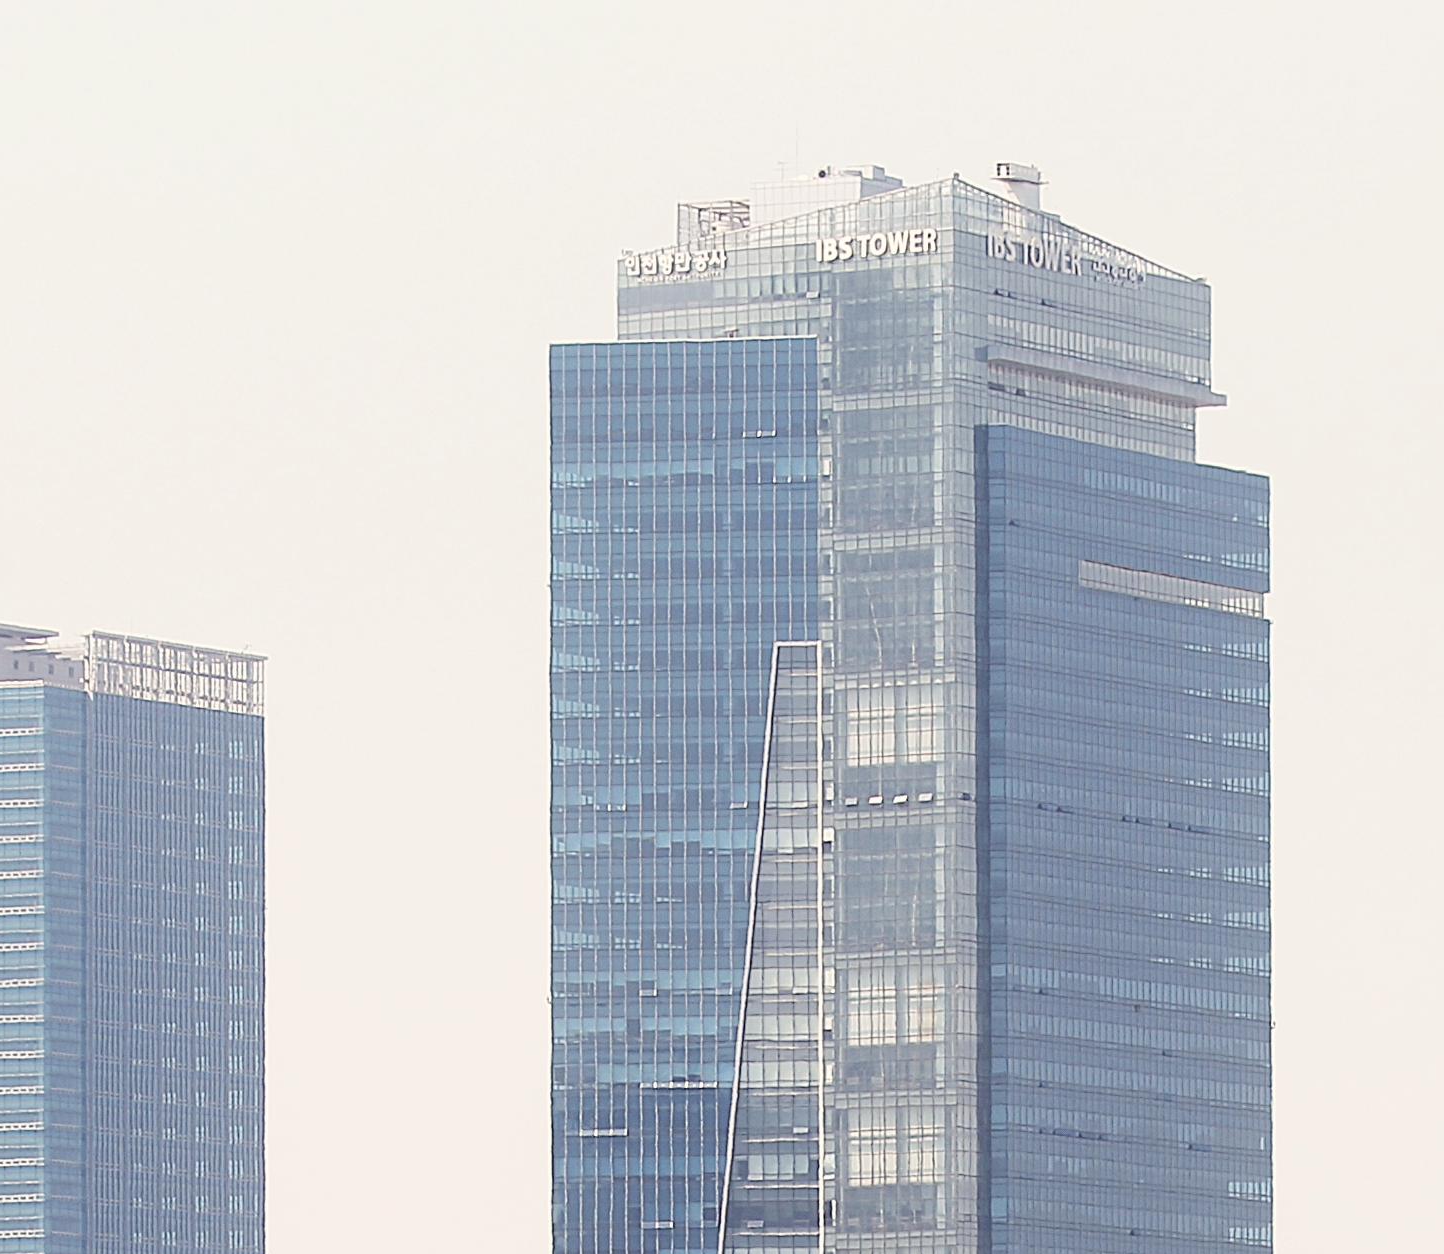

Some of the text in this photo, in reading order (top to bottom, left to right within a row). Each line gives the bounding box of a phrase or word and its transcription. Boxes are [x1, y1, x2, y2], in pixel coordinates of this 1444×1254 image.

[624, 248, 727, 276] 인천항만공사
[815, 228, 938, 262] IBS TOWER
[987, 233, 1016, 263] IBS
[1023, 236, 1083, 277] TOWER
